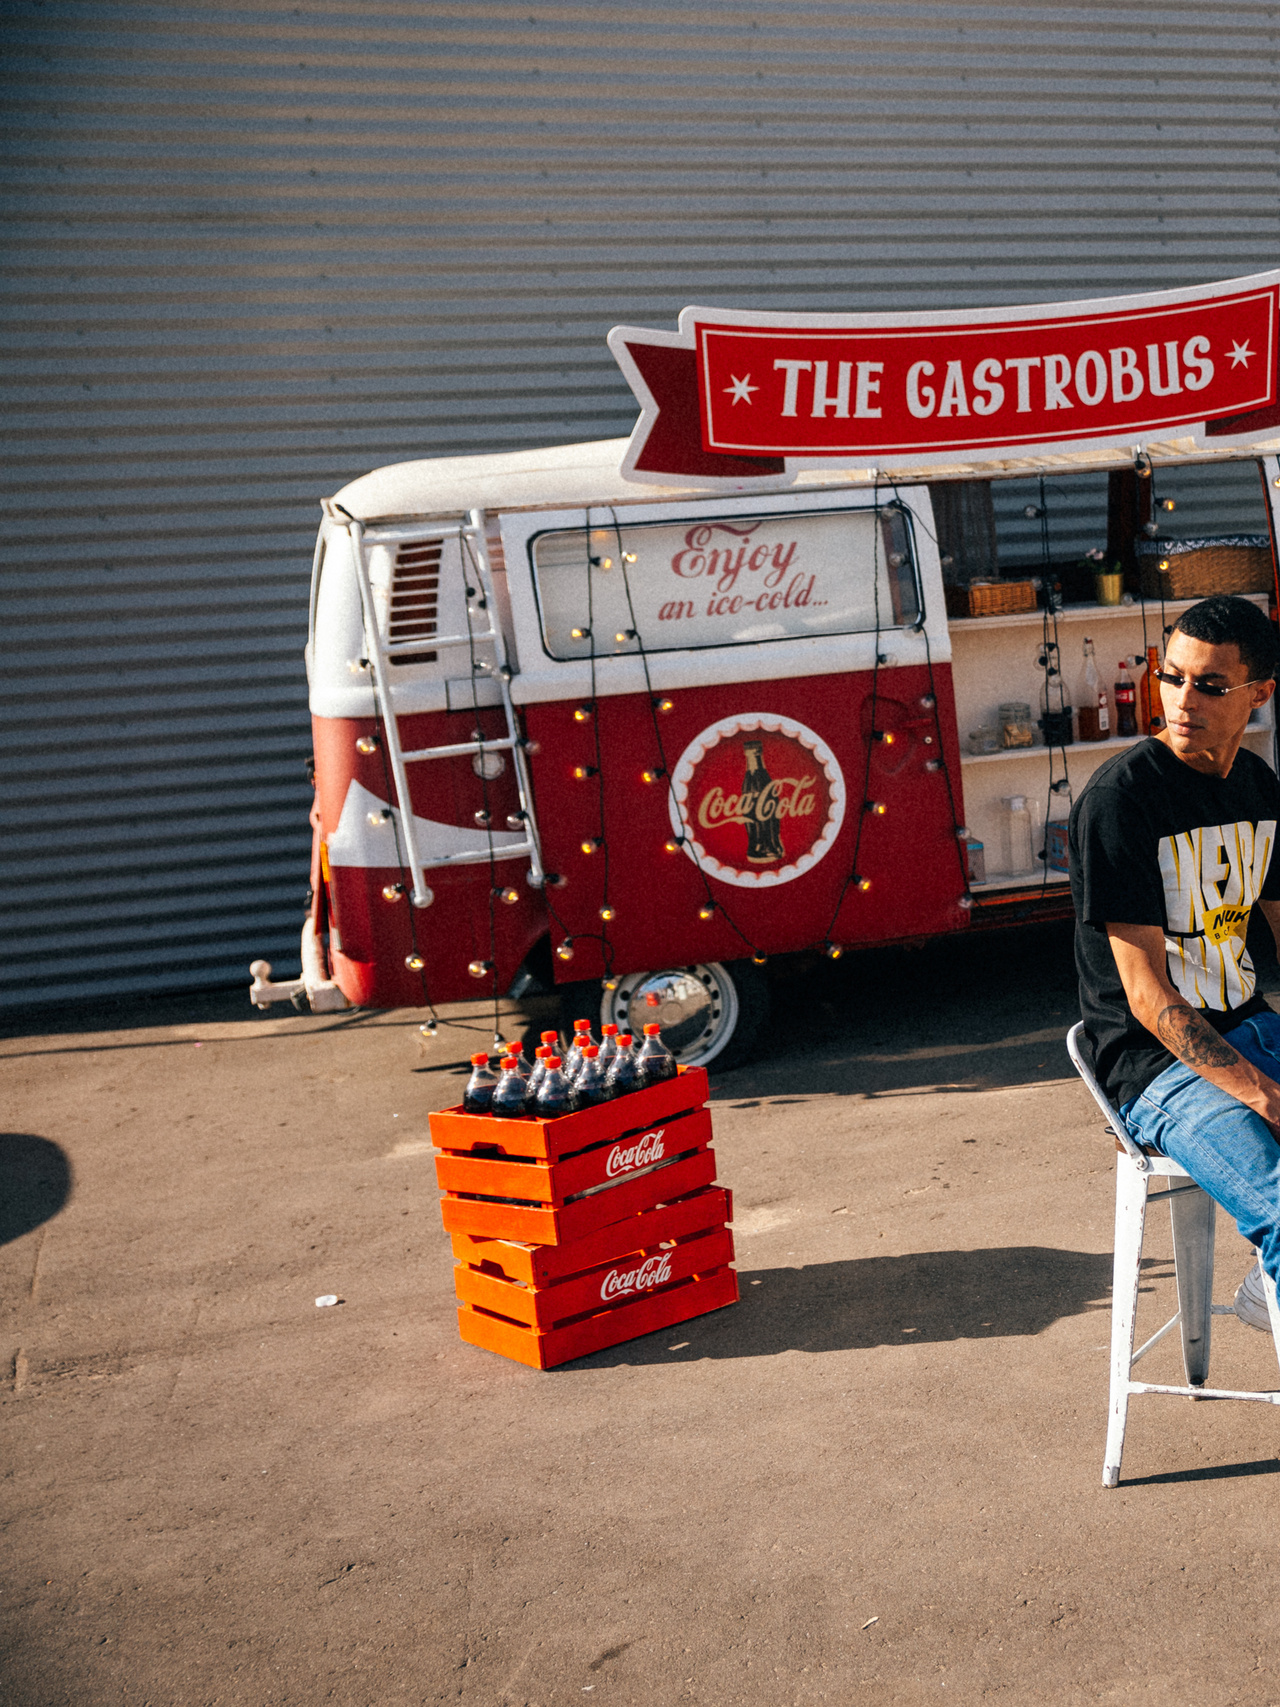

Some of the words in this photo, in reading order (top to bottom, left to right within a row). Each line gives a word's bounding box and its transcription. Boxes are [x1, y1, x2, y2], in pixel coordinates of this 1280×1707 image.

[773, 357, 884, 419] THE
[906, 335, 1215, 419] GASTROBUS
[671, 520, 799, 593] Enjoy
[658, 597, 695, 621] an
[698, 775, 817, 829] Coca-Cola
[606, 1129, 665, 1177] Coca-Cola
[601, 1252, 672, 1301] Coca-Cola
